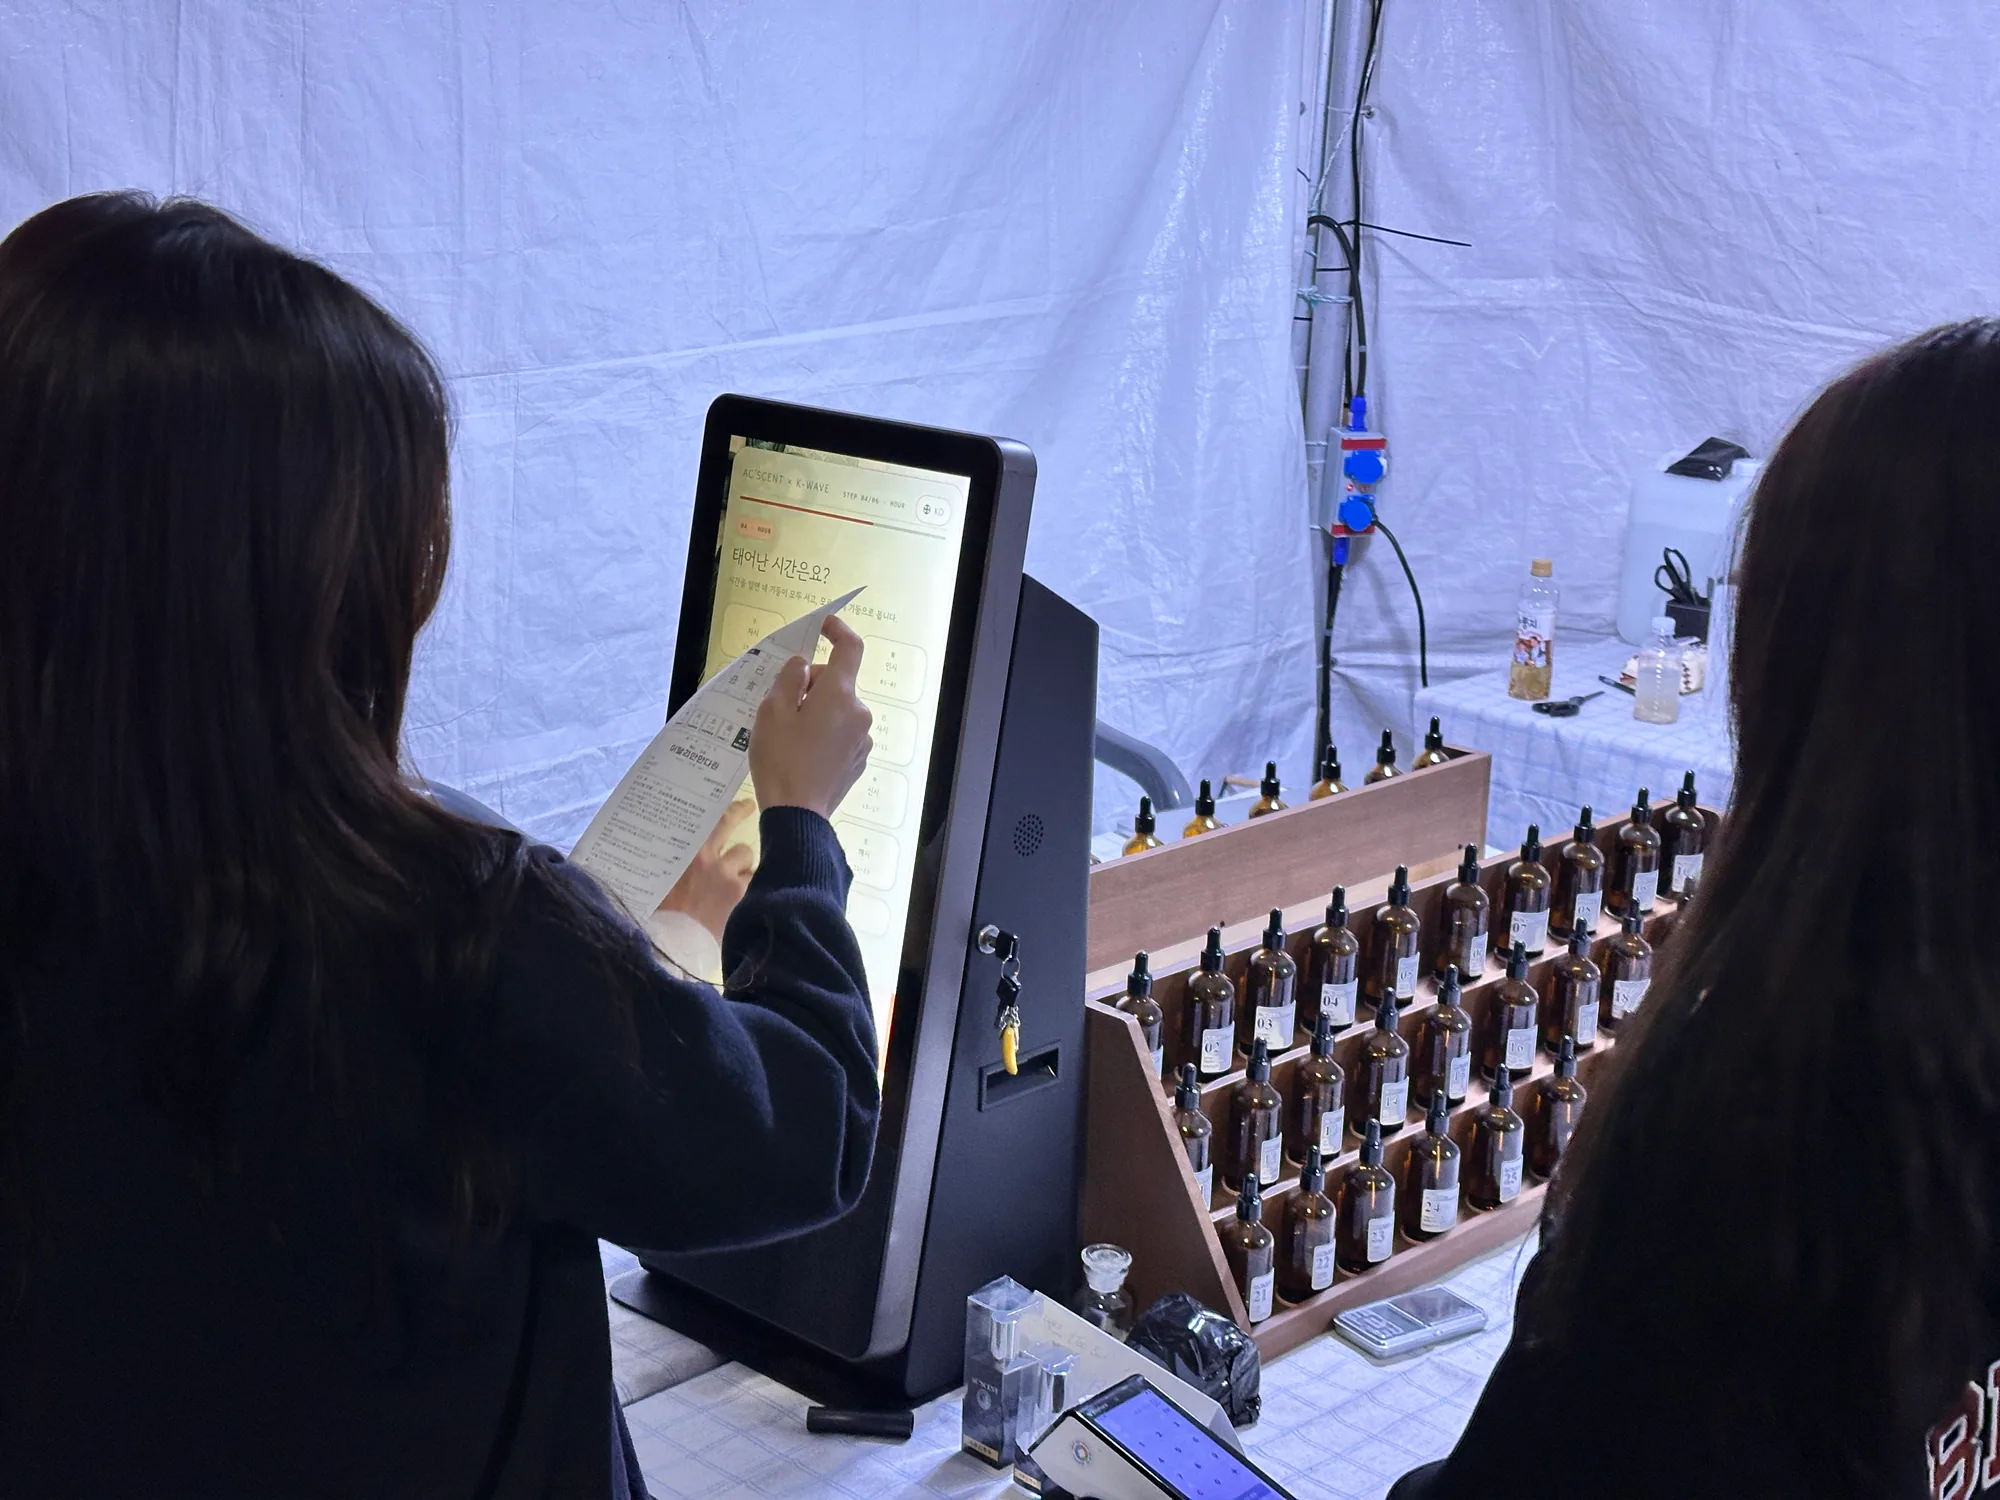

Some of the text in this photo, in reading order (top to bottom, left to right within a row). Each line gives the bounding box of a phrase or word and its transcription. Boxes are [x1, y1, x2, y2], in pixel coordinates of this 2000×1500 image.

[742, 468, 784, 484] AC'SCENT
[796, 478, 830, 494] K-WAVE
[843, 491, 858, 500] STEP
[890, 501, 906, 509] HOUR
[934, 507, 945, 516] KO
[732, 548, 831, 584] 태어난 시간은요?
[769, 585, 788, 598] 기둥이
[790, 591, 803, 601] 모두
[848, 604, 874, 617] 기둥으로
[875, 610, 898, 623] 봅니다.
[1512, 923, 1527, 933] 07
[1323, 995, 1339, 1007] 04
[1257, 1017, 1273, 1030] 03
[1204, 1041, 1220, 1053] 02
[1424, 1201, 1440, 1213] 24
[1253, 1288, 1266, 1302] 21
